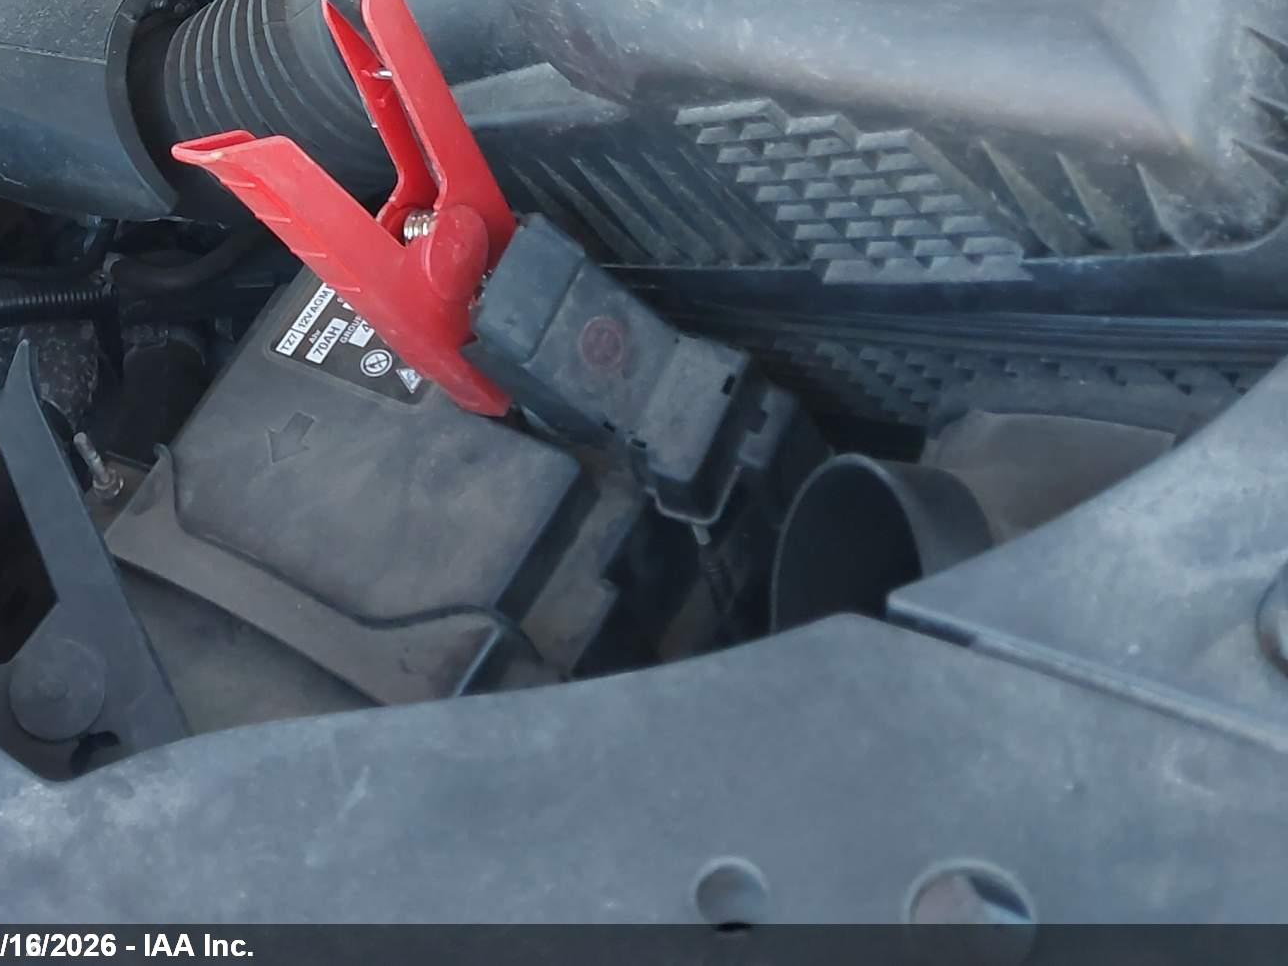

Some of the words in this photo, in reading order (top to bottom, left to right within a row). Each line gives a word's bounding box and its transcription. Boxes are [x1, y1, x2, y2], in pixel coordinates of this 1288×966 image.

[298, 312, 312, 328] 12V
[310, 288, 328, 312] AGM
[314, 324, 340, 356] 70AH
